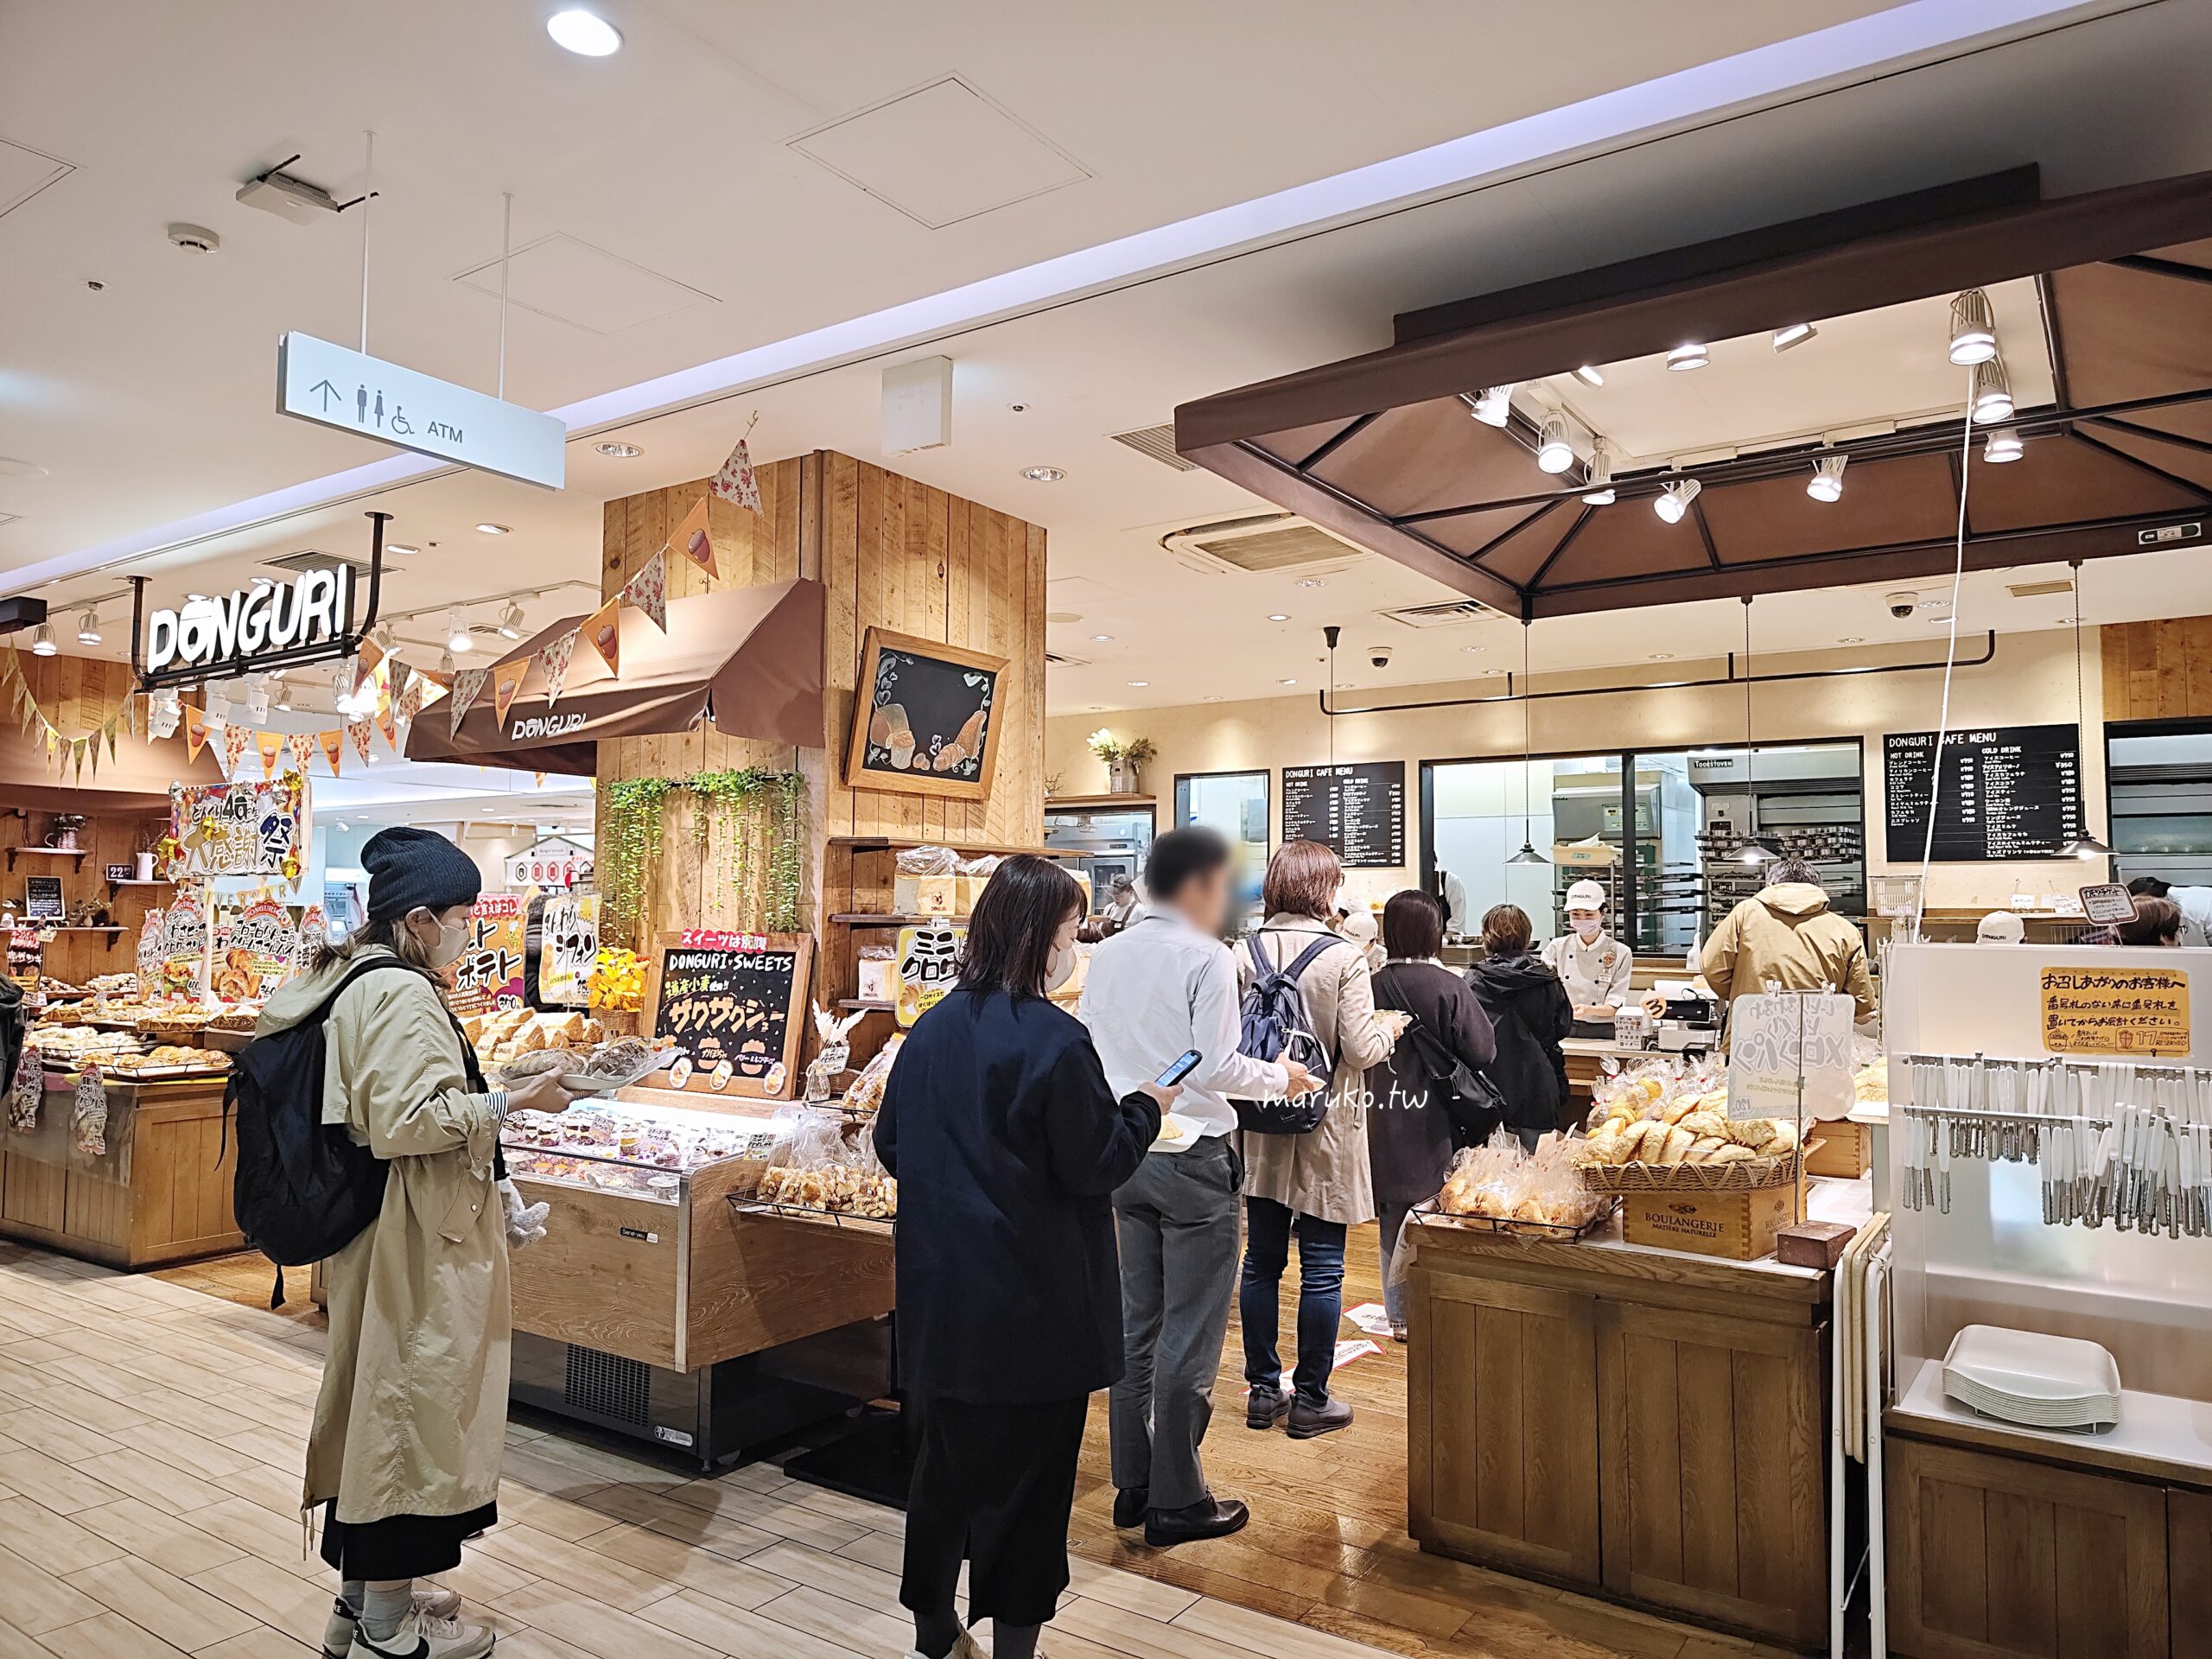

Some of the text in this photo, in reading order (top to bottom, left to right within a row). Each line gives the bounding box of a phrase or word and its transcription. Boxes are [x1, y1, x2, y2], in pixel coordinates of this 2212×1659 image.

[427, 421, 464, 444] ATM
[147, 563, 349, 674] DONGURI
[511, 713, 587, 741] DONGURI
[1889, 735, 1933, 747] DONGURI
[1969, 732, 1997, 744] MENU
[1285, 769, 1313, 779] DONGURI
[1316, 768, 1332, 777] CAFE
[110, 867, 124, 878] 22
[246, 905, 277, 918] DONGURI
[556, 934, 597, 965] シフォン
[913, 931, 956, 956] ミニ
[458, 950, 520, 988] ポテト
[669, 952, 793, 972] DONGURI SWEETS
[2041, 973, 2186, 990] お召しあがりのお客様へ
[1645, 998, 1663, 1016] 3
[2046, 995, 2178, 1011] 番号札のない席に番号札を
[668, 996, 785, 1034] ザクザクシュー
[2136, 1030, 2158, 1046] 17
[1645, 1212, 1725, 1233] BOULANGERIE
[1652, 1222, 1717, 1238] MATIÈRE NATURELLE
